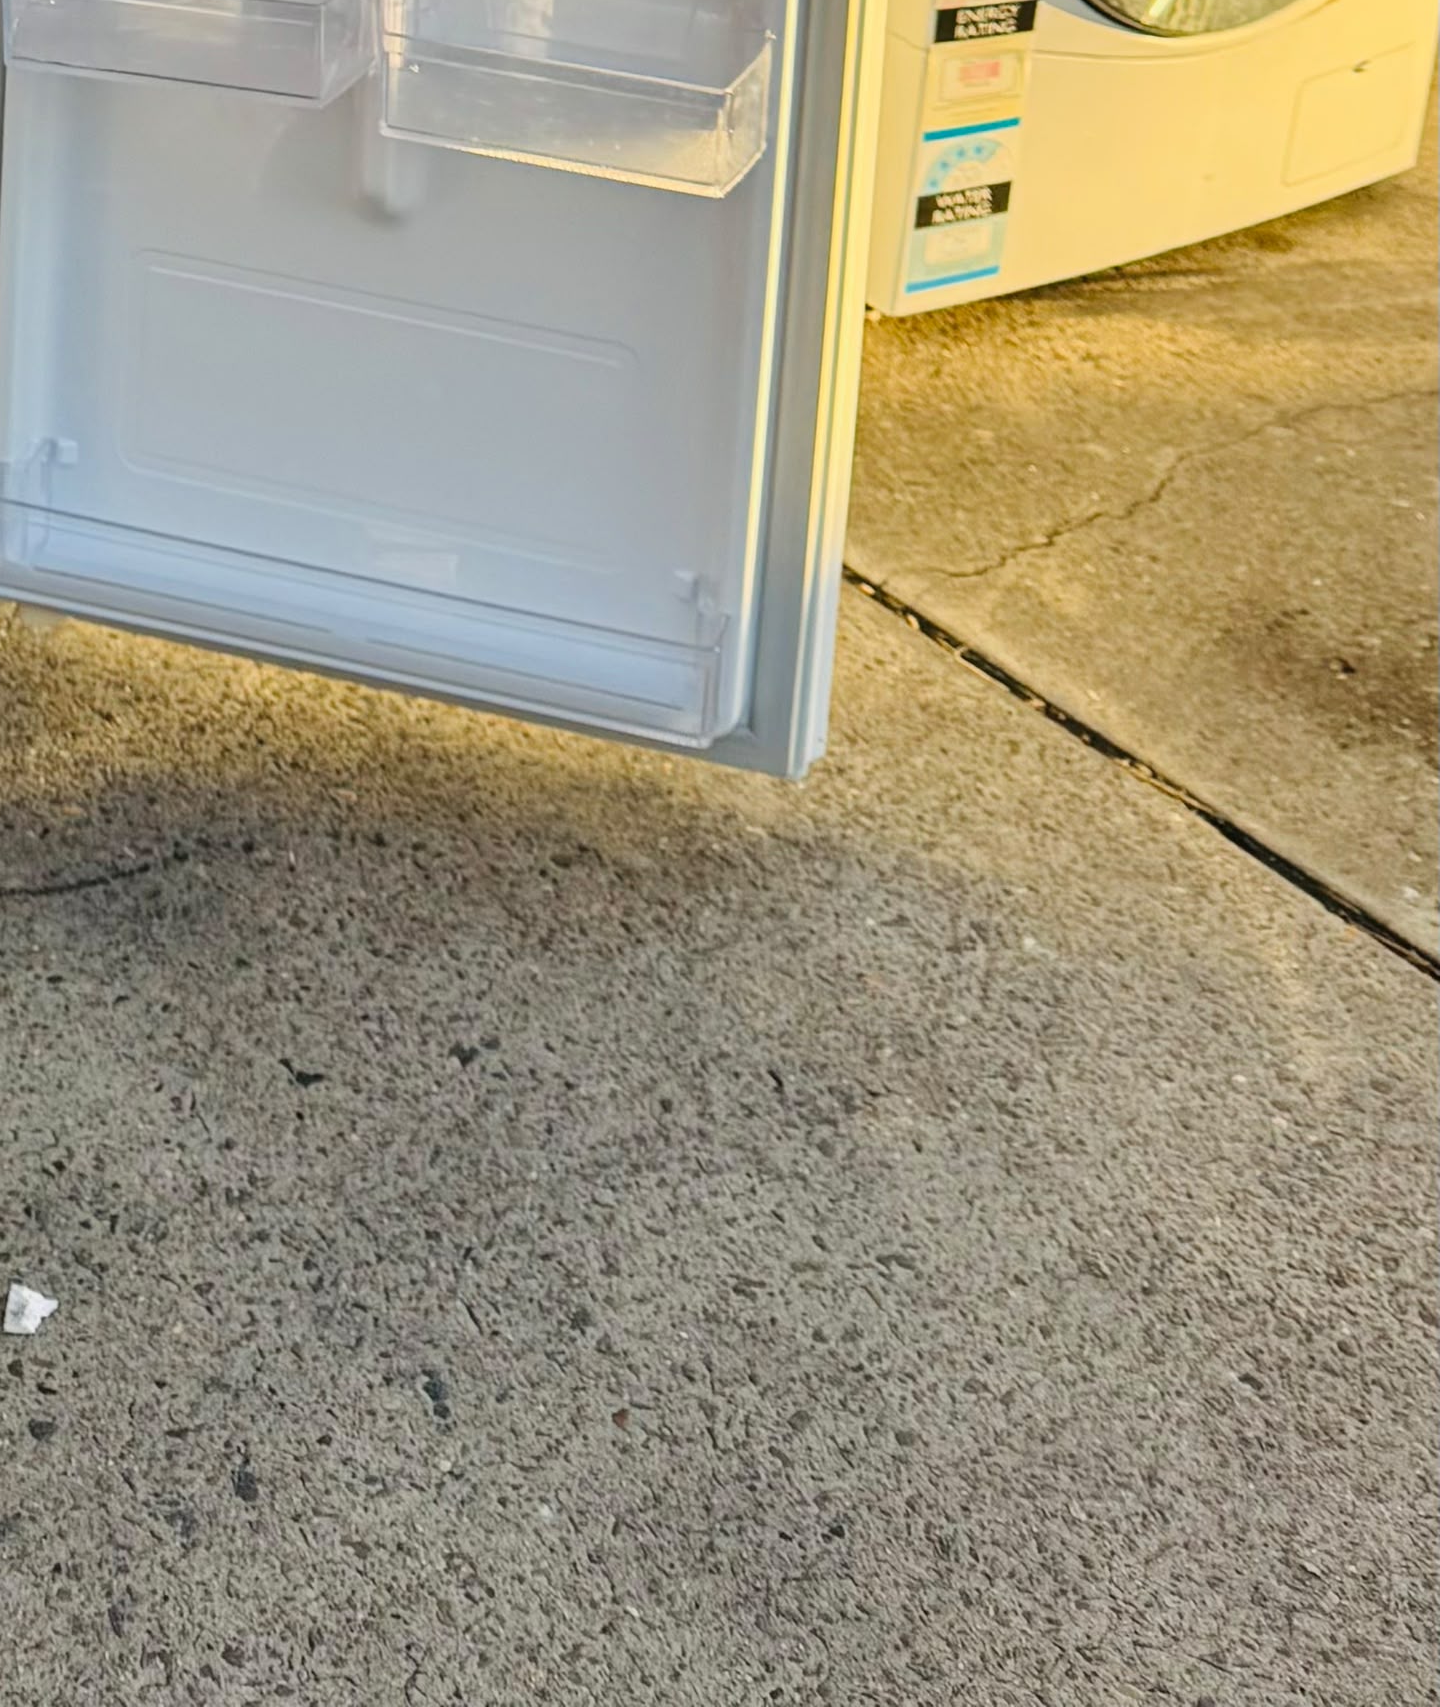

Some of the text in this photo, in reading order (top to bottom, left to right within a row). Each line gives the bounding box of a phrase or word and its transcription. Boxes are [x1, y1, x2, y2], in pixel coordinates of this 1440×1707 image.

[955, 4, 1020, 25] ENERGY
[954, 17, 1018, 40] RATING
[931, 201, 993, 224] RATING
